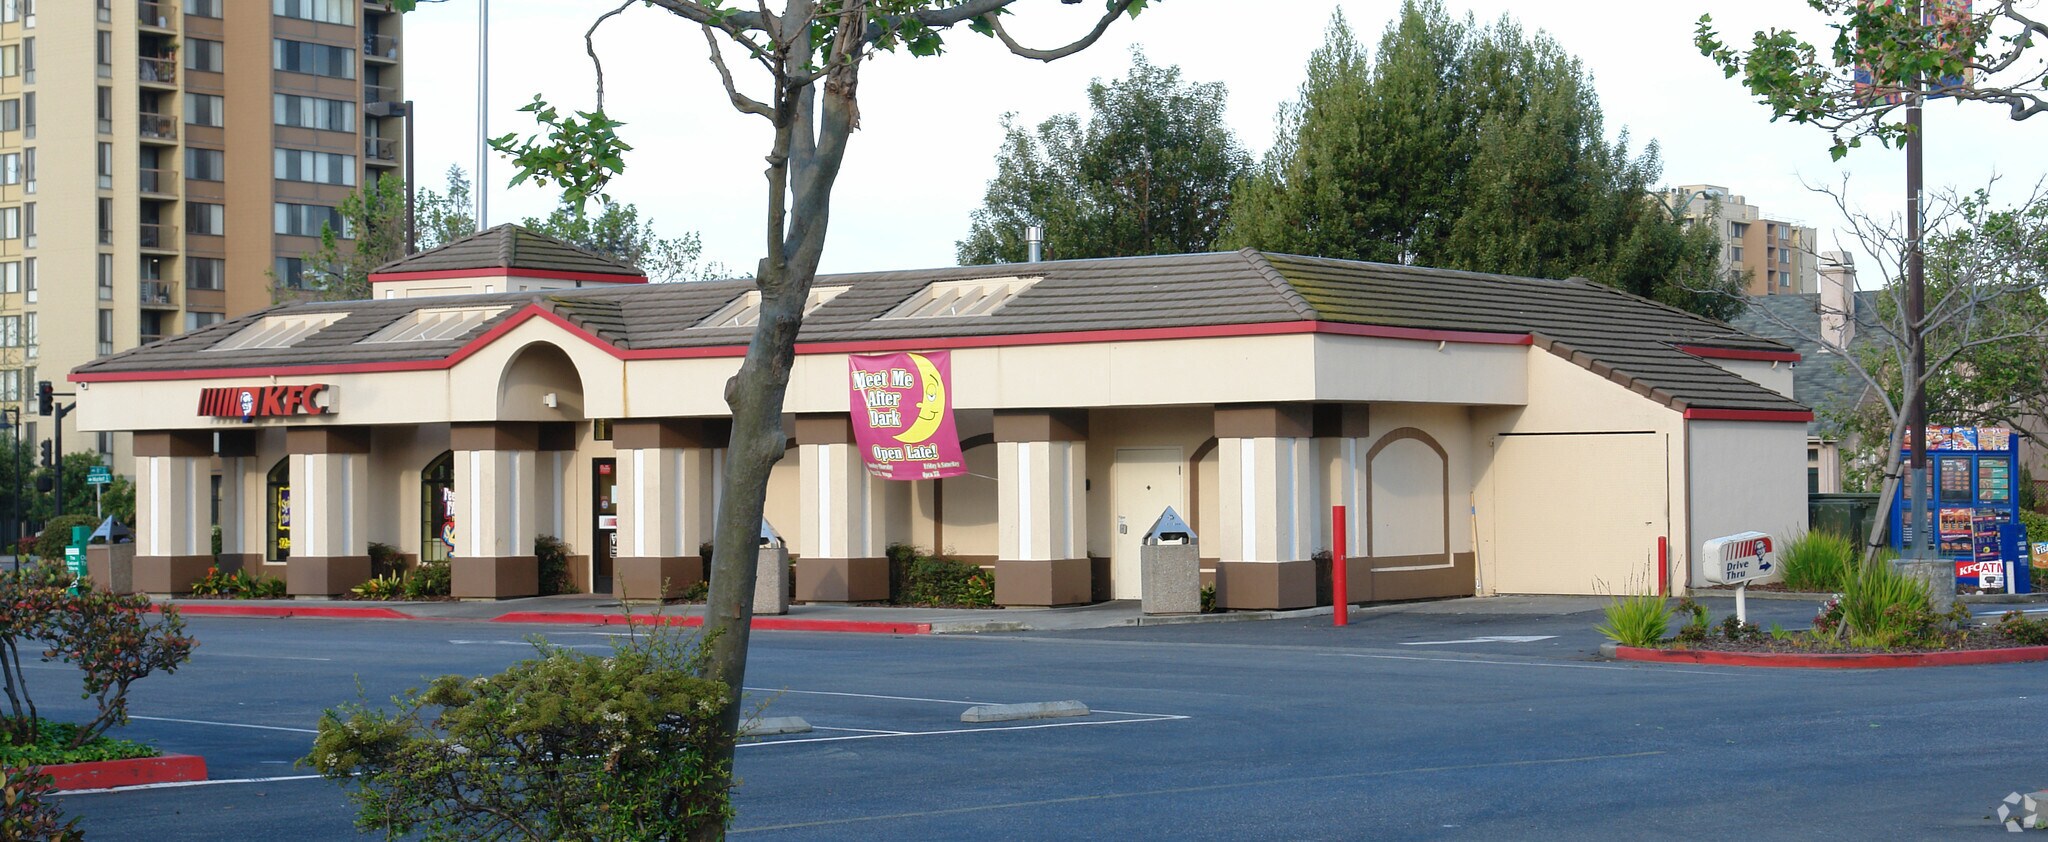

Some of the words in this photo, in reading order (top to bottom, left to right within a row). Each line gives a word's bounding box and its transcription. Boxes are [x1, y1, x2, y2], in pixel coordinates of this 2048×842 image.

[852, 371, 888, 390] Meet
[891, 369, 914, 388] Me
[261, 383, 326, 415] KFC
[867, 389, 900, 407] After
[869, 409, 900, 427] Dark
[873, 445, 903, 462] Open
[905, 444, 938, 460] Late!
[1726, 560, 1749, 572] Drive
[1727, 570, 1746, 580] Thru
[1959, 563, 1980, 576] KFC
